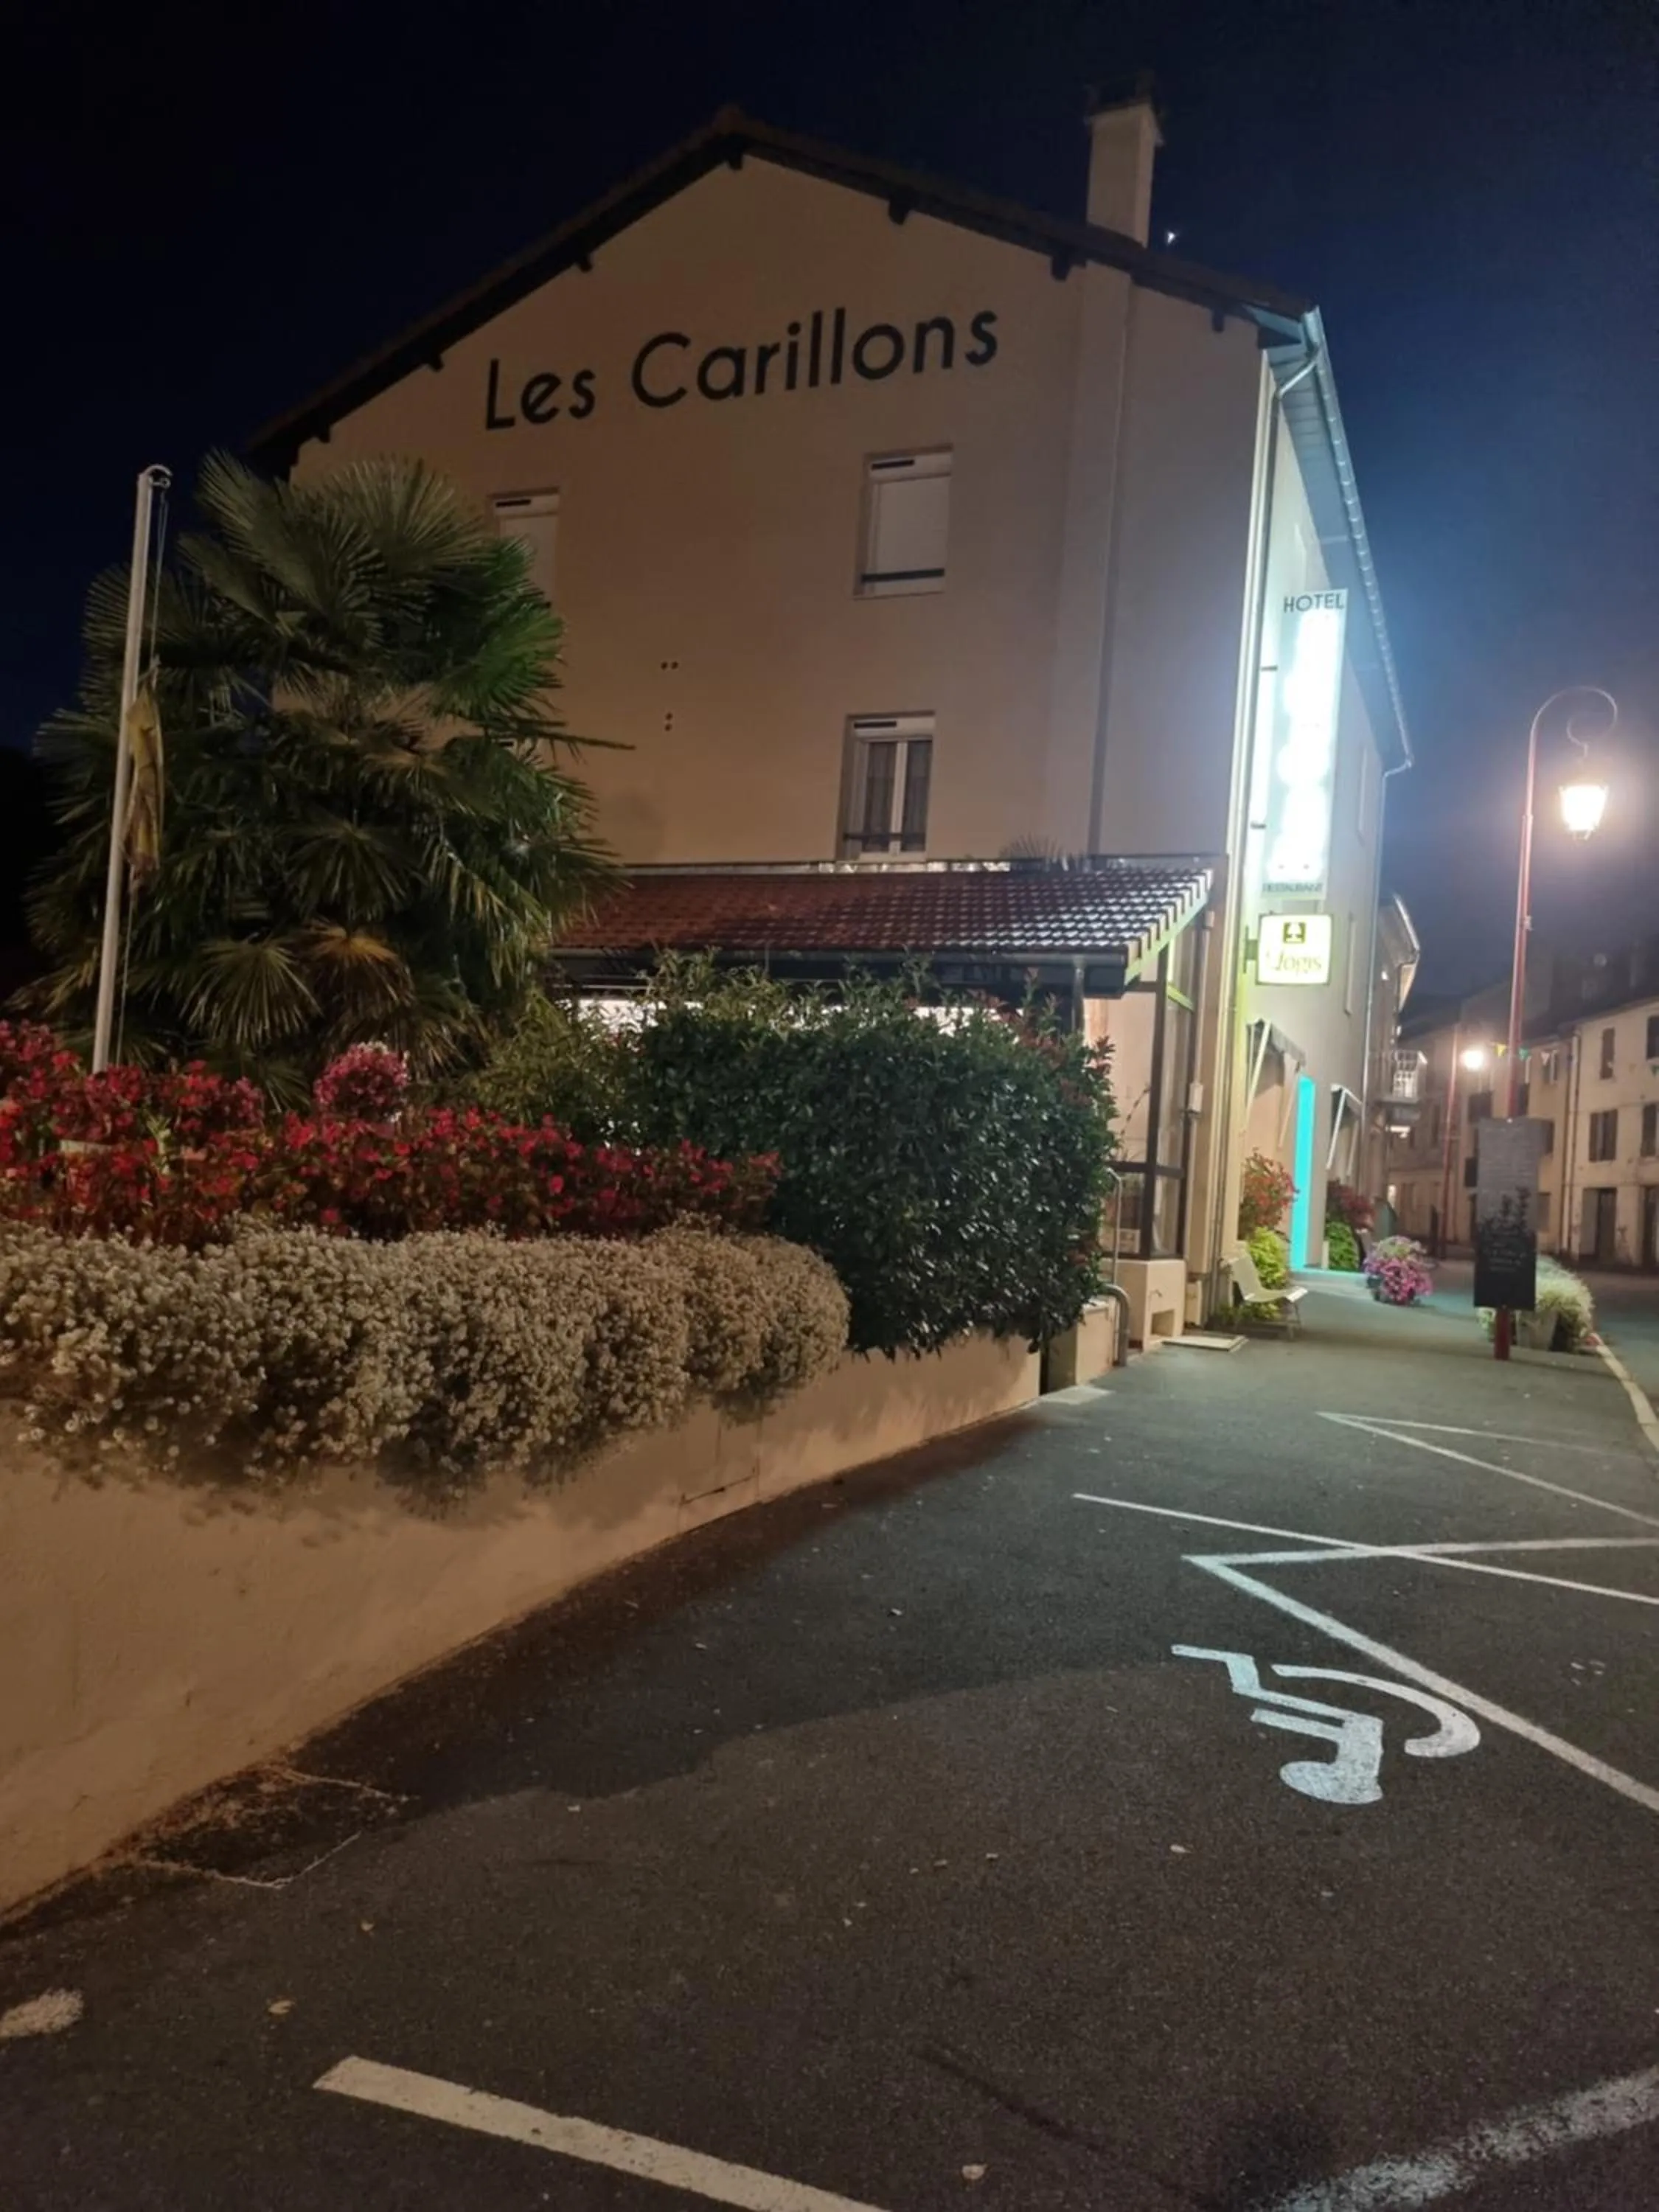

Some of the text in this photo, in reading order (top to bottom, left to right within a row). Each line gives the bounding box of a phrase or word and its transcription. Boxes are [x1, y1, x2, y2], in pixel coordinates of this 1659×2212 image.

[484, 307, 998, 431] Les Carillons
[1284, 593, 1345, 613] HOTEL
